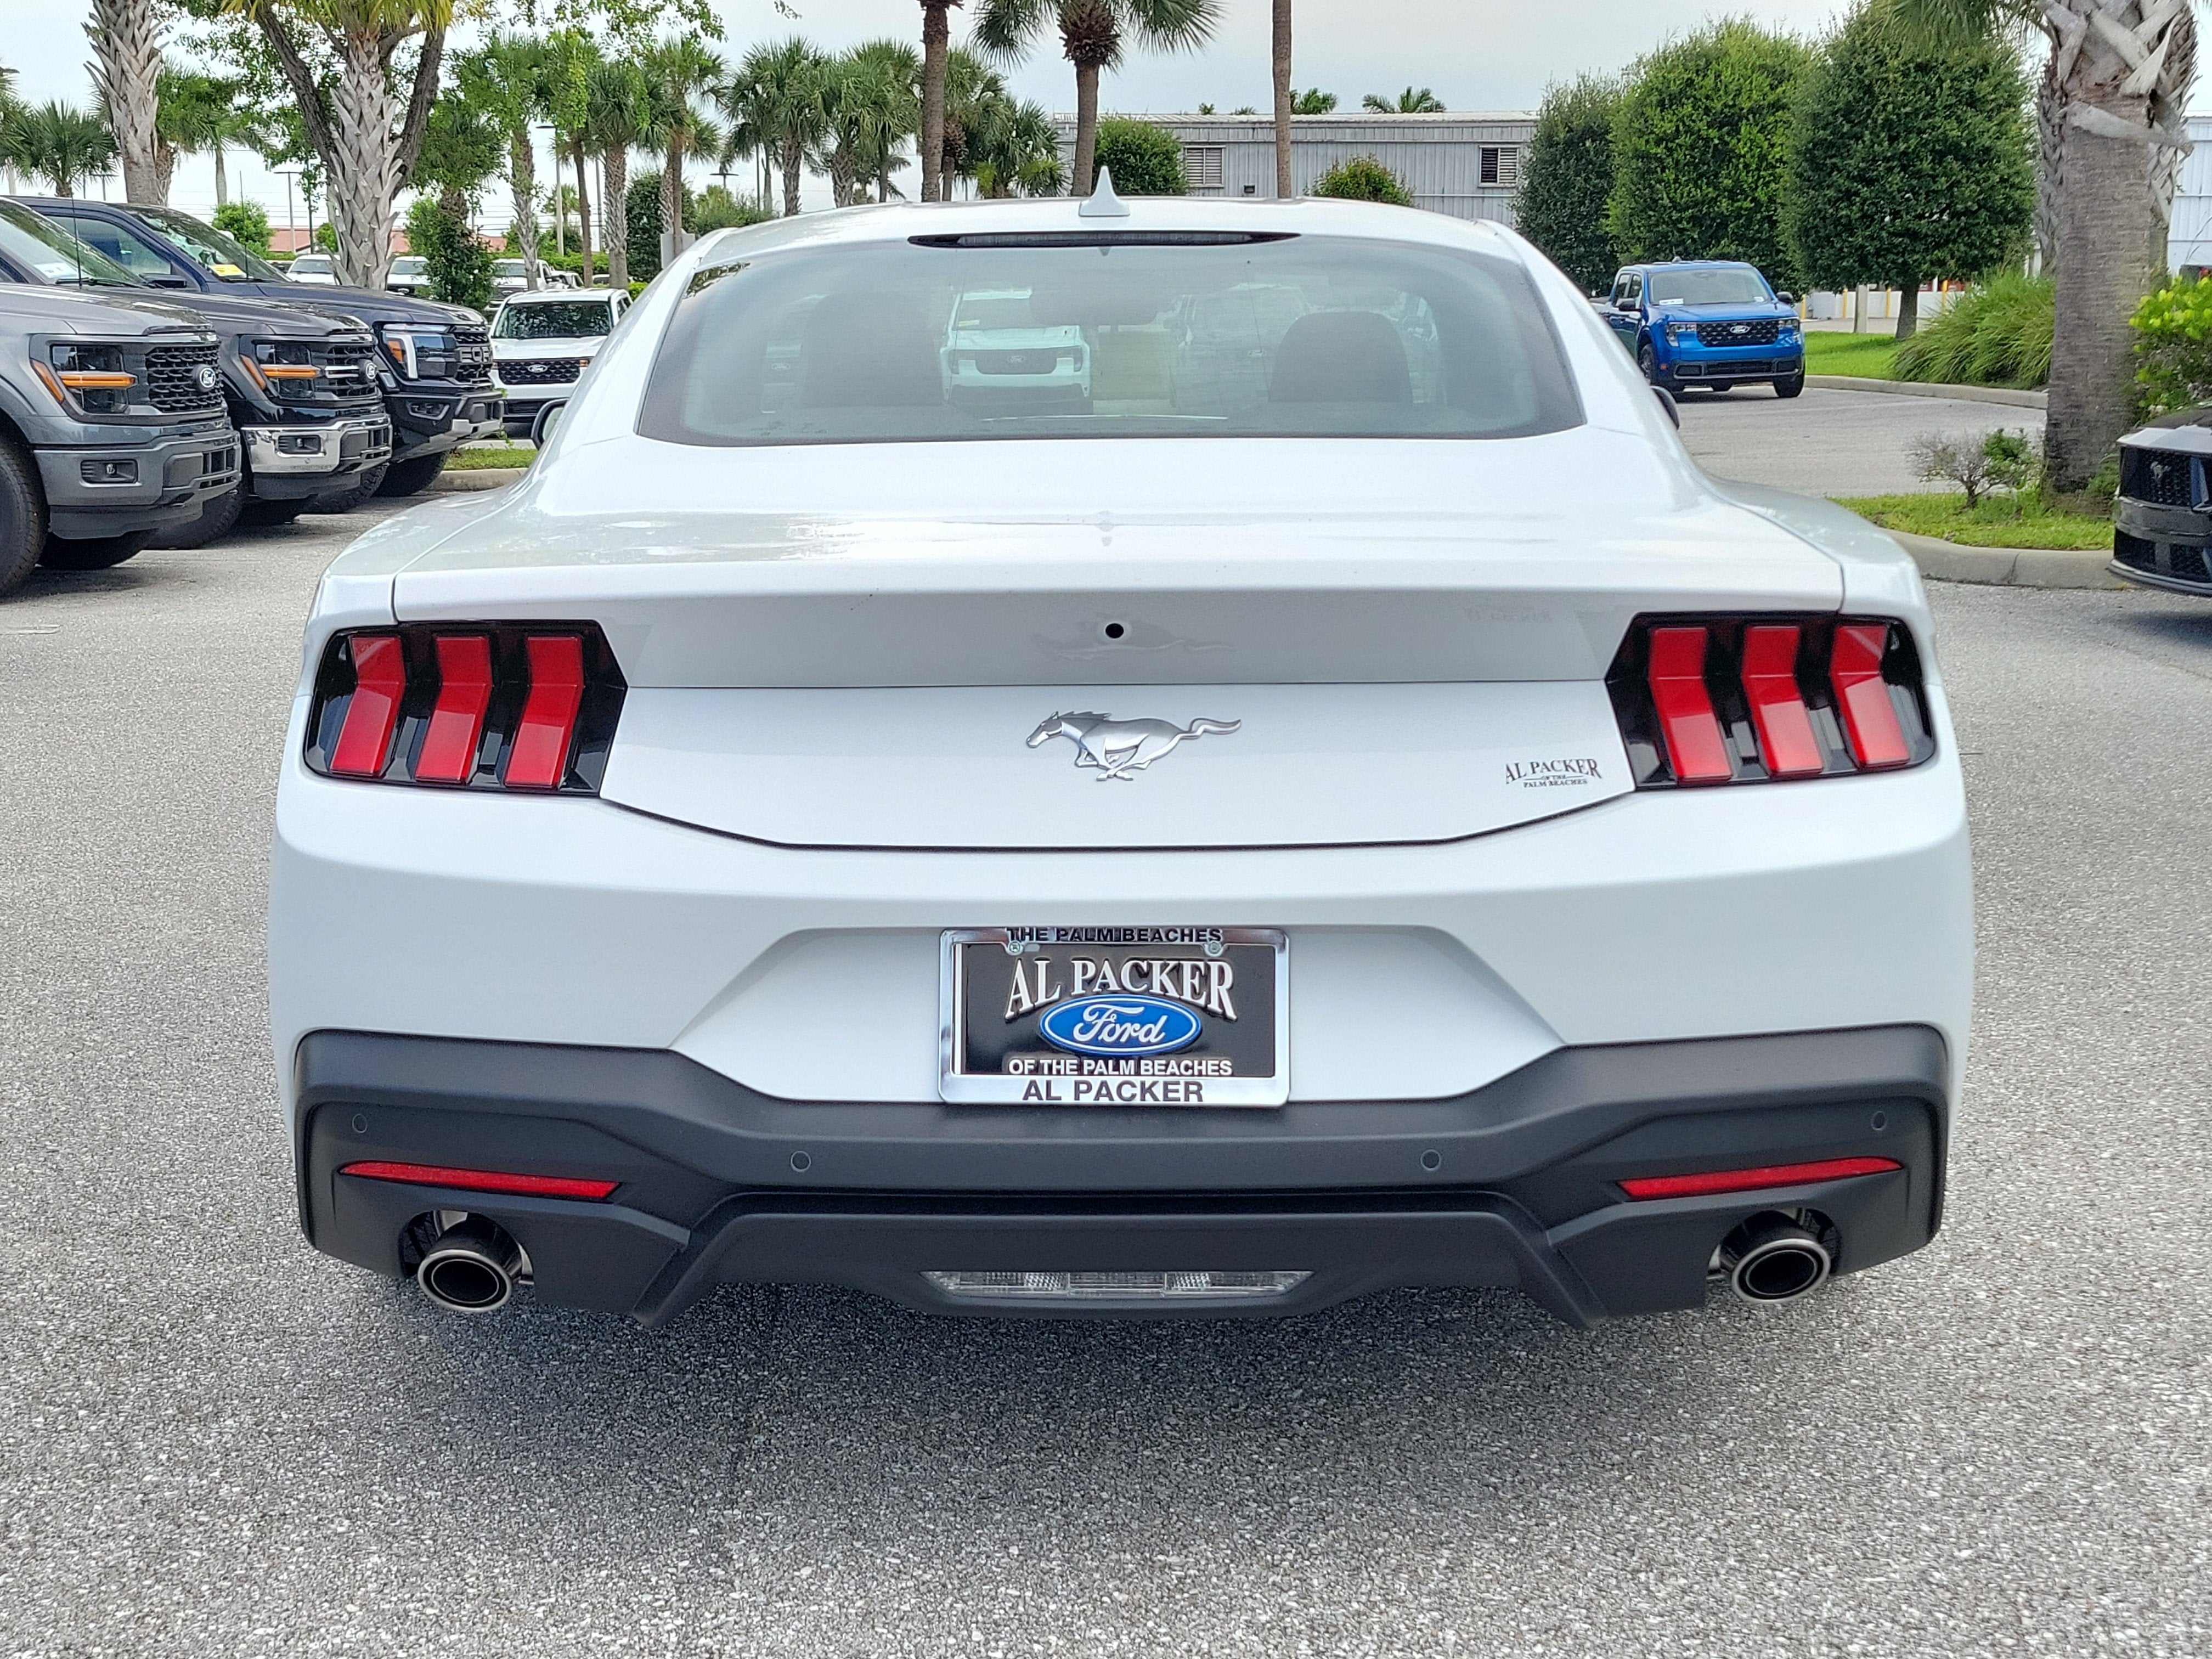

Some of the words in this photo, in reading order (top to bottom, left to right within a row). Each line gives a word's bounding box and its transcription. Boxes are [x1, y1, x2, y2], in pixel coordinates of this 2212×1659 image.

[1505, 763, 1527, 784] AL
[1530, 759, 1602, 779] PACKER
[1006, 927, 1048, 941] THE
[1056, 927, 1113, 942] PALM
[1122, 927, 1222, 943] BEACHES
[1005, 958, 1060, 1019] AL
[1071, 959, 1238, 1021] PACKER
[1073, 1003, 1168, 1043] Ford
[1008, 1059, 1035, 1075] OF
[1040, 1059, 1078, 1075] THE
[1083, 1059, 1135, 1075] PALM
[1139, 1059, 1233, 1076] BEACHES
[1022, 1079, 1062, 1101] AL
[1074, 1079, 1204, 1102] PACKER
